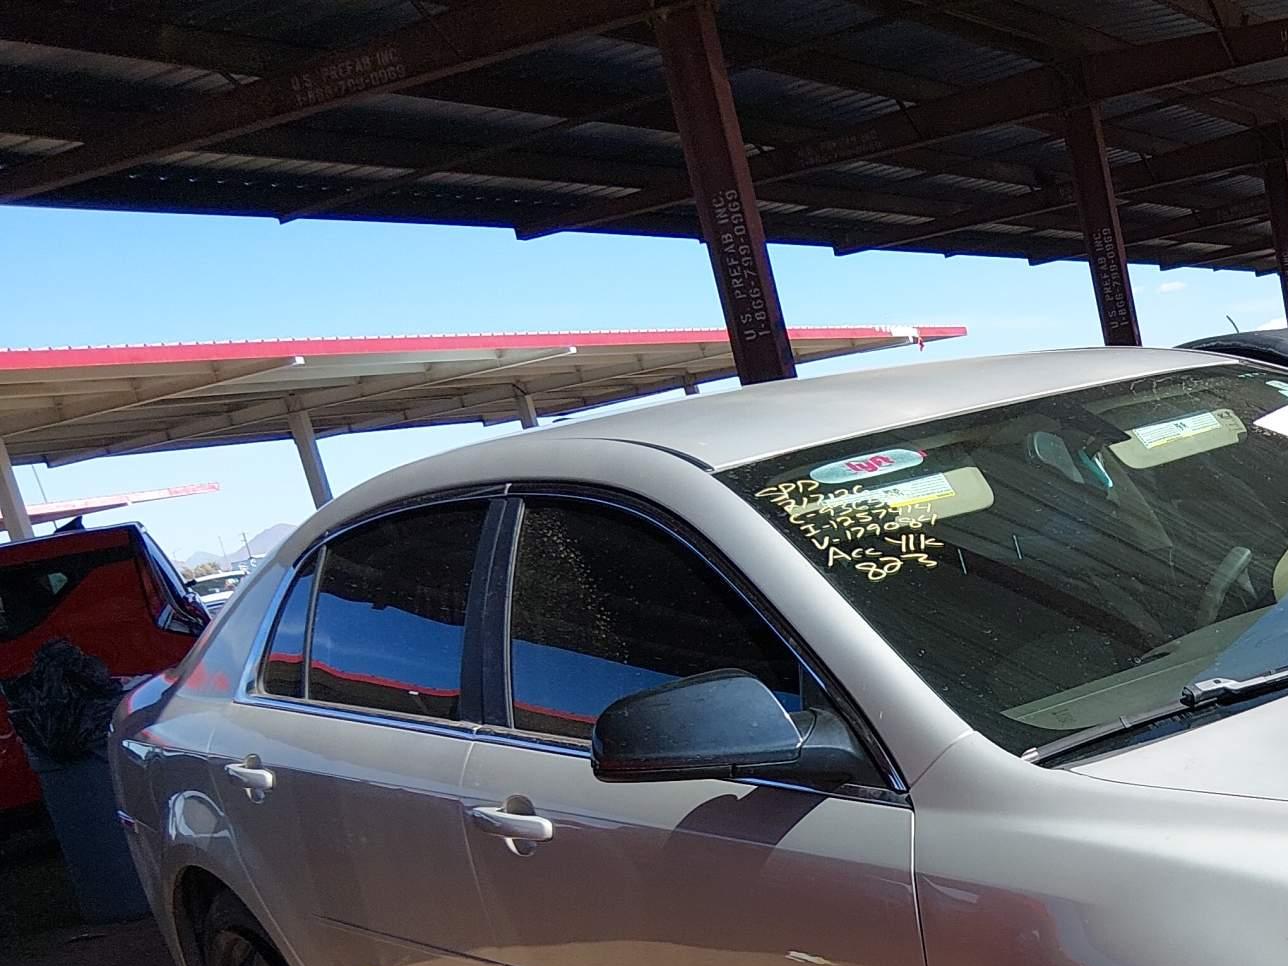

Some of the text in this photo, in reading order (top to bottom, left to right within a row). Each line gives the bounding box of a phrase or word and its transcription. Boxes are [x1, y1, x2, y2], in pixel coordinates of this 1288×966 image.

[712, 190, 730, 225] INC.
[721, 232, 748, 300] PREFAB
[724, 188, 772, 337] 1-866-799-0969
[1097, 256, 1115, 302] PREFAB
